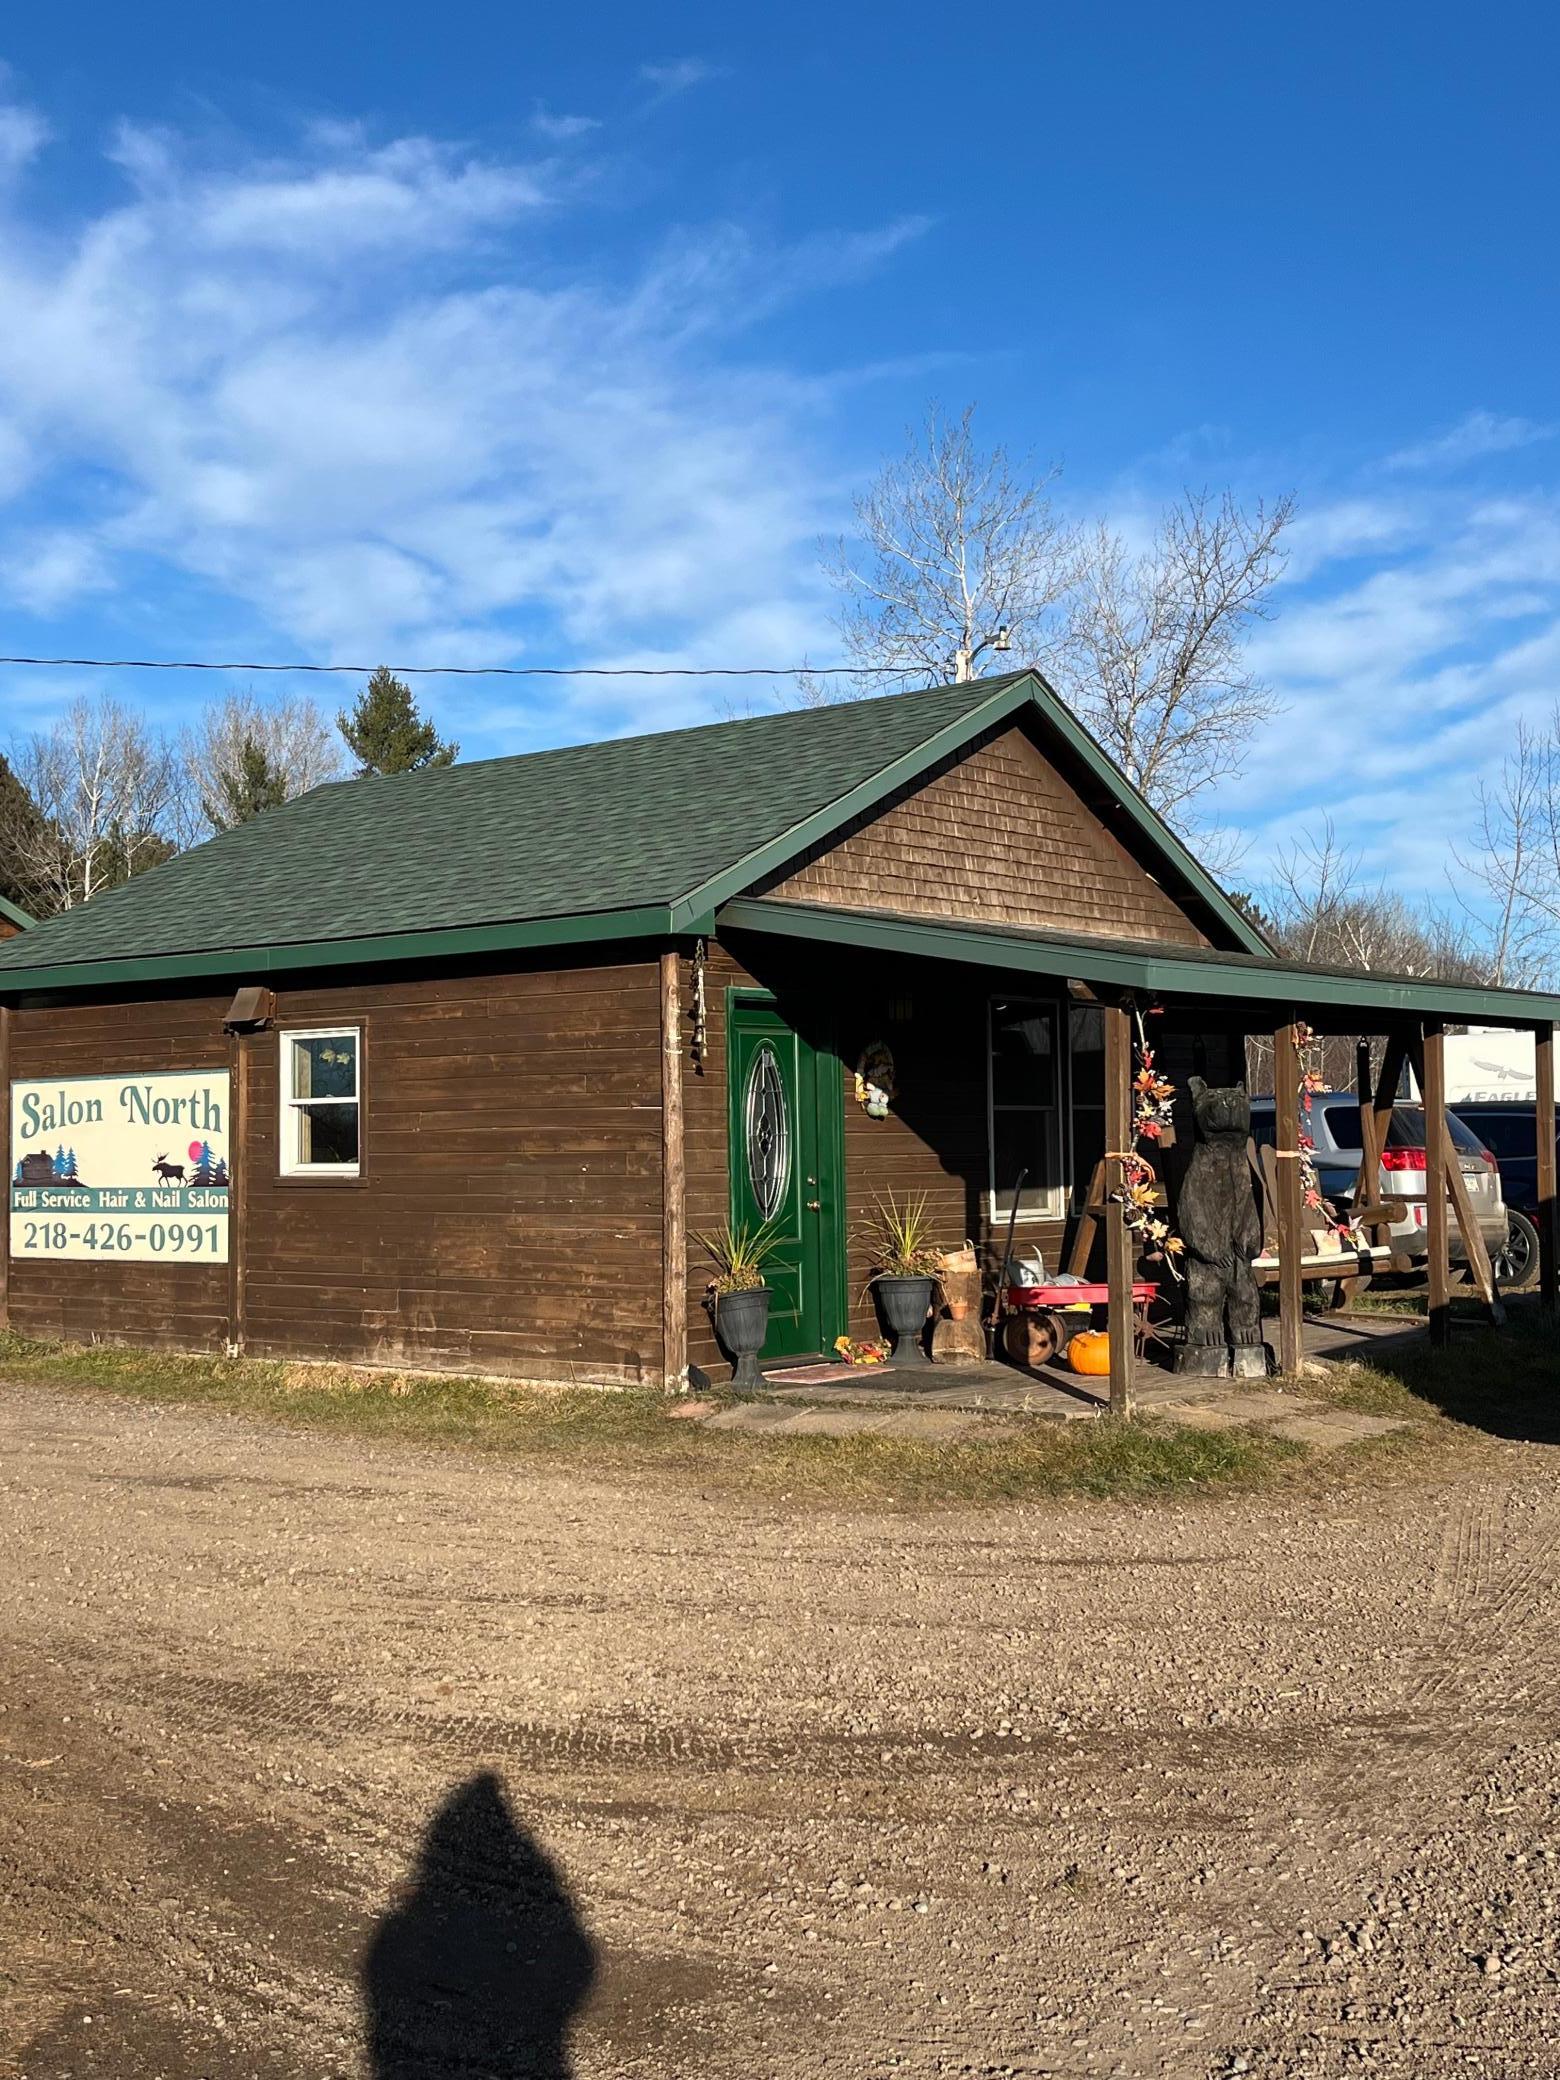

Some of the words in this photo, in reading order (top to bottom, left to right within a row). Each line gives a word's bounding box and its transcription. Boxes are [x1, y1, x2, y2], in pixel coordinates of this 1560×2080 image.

[20, 1090, 103, 1139] Salon
[120, 1085, 223, 1133] North
[14, 1191, 37, 1208] Full
[41, 1191, 91, 1208] Service
[99, 1190, 128, 1208] Hair
[134, 1191, 146, 1208] &
[152, 1190, 181, 1208] Nail
[188, 1190, 229, 1208] Salon
[24, 1222, 218, 1253] 218-426-0991
